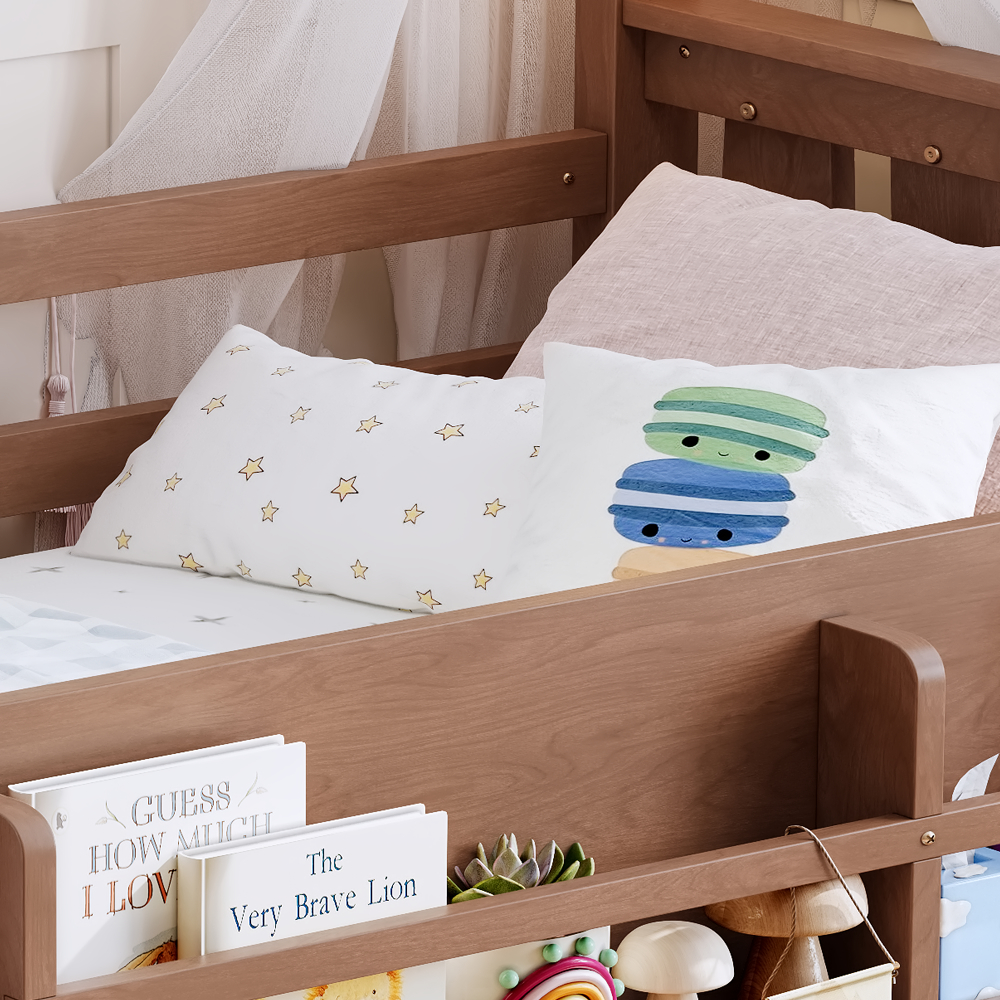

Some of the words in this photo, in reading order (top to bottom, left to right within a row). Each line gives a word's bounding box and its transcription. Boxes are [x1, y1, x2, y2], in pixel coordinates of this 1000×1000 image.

[131, 781, 232, 826] GUESS
[88, 831, 167, 875] HOW
[177, 811, 274, 850] MUCH
[306, 848, 343, 876] The
[81, 884, 94, 919] I
[107, 868, 178, 916] LOV
[230, 904, 283, 937] Very
[294, 889, 357, 921] Brave
[367, 876, 417, 906] Lion
